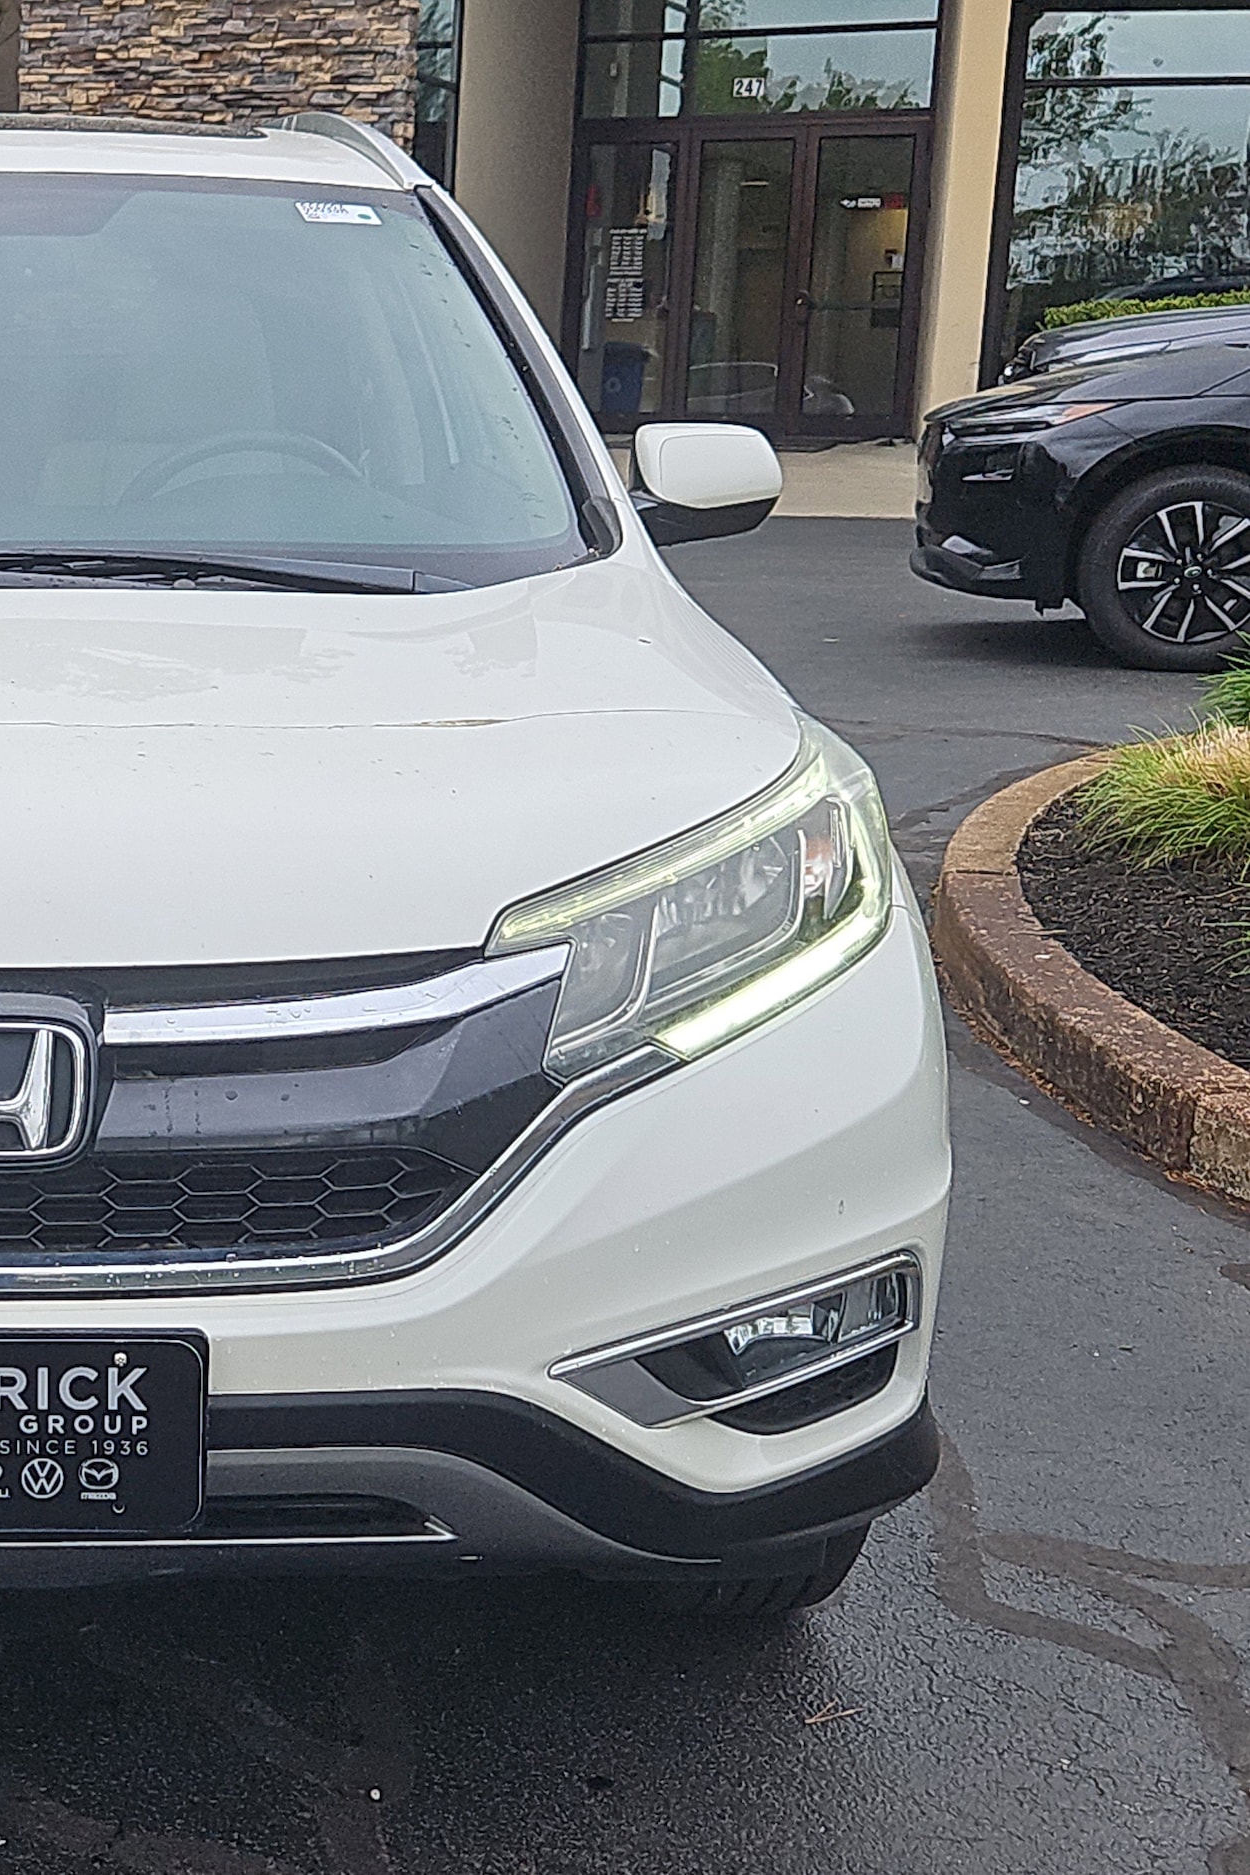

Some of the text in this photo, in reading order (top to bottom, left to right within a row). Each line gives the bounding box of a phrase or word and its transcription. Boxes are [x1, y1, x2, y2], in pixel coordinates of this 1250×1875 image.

[735, 79, 763, 96] 247
[19, 1414, 148, 1435] GROUP
[0, 1439, 77, 1455] SINCE
[92, 1440, 149, 1456] 1936
